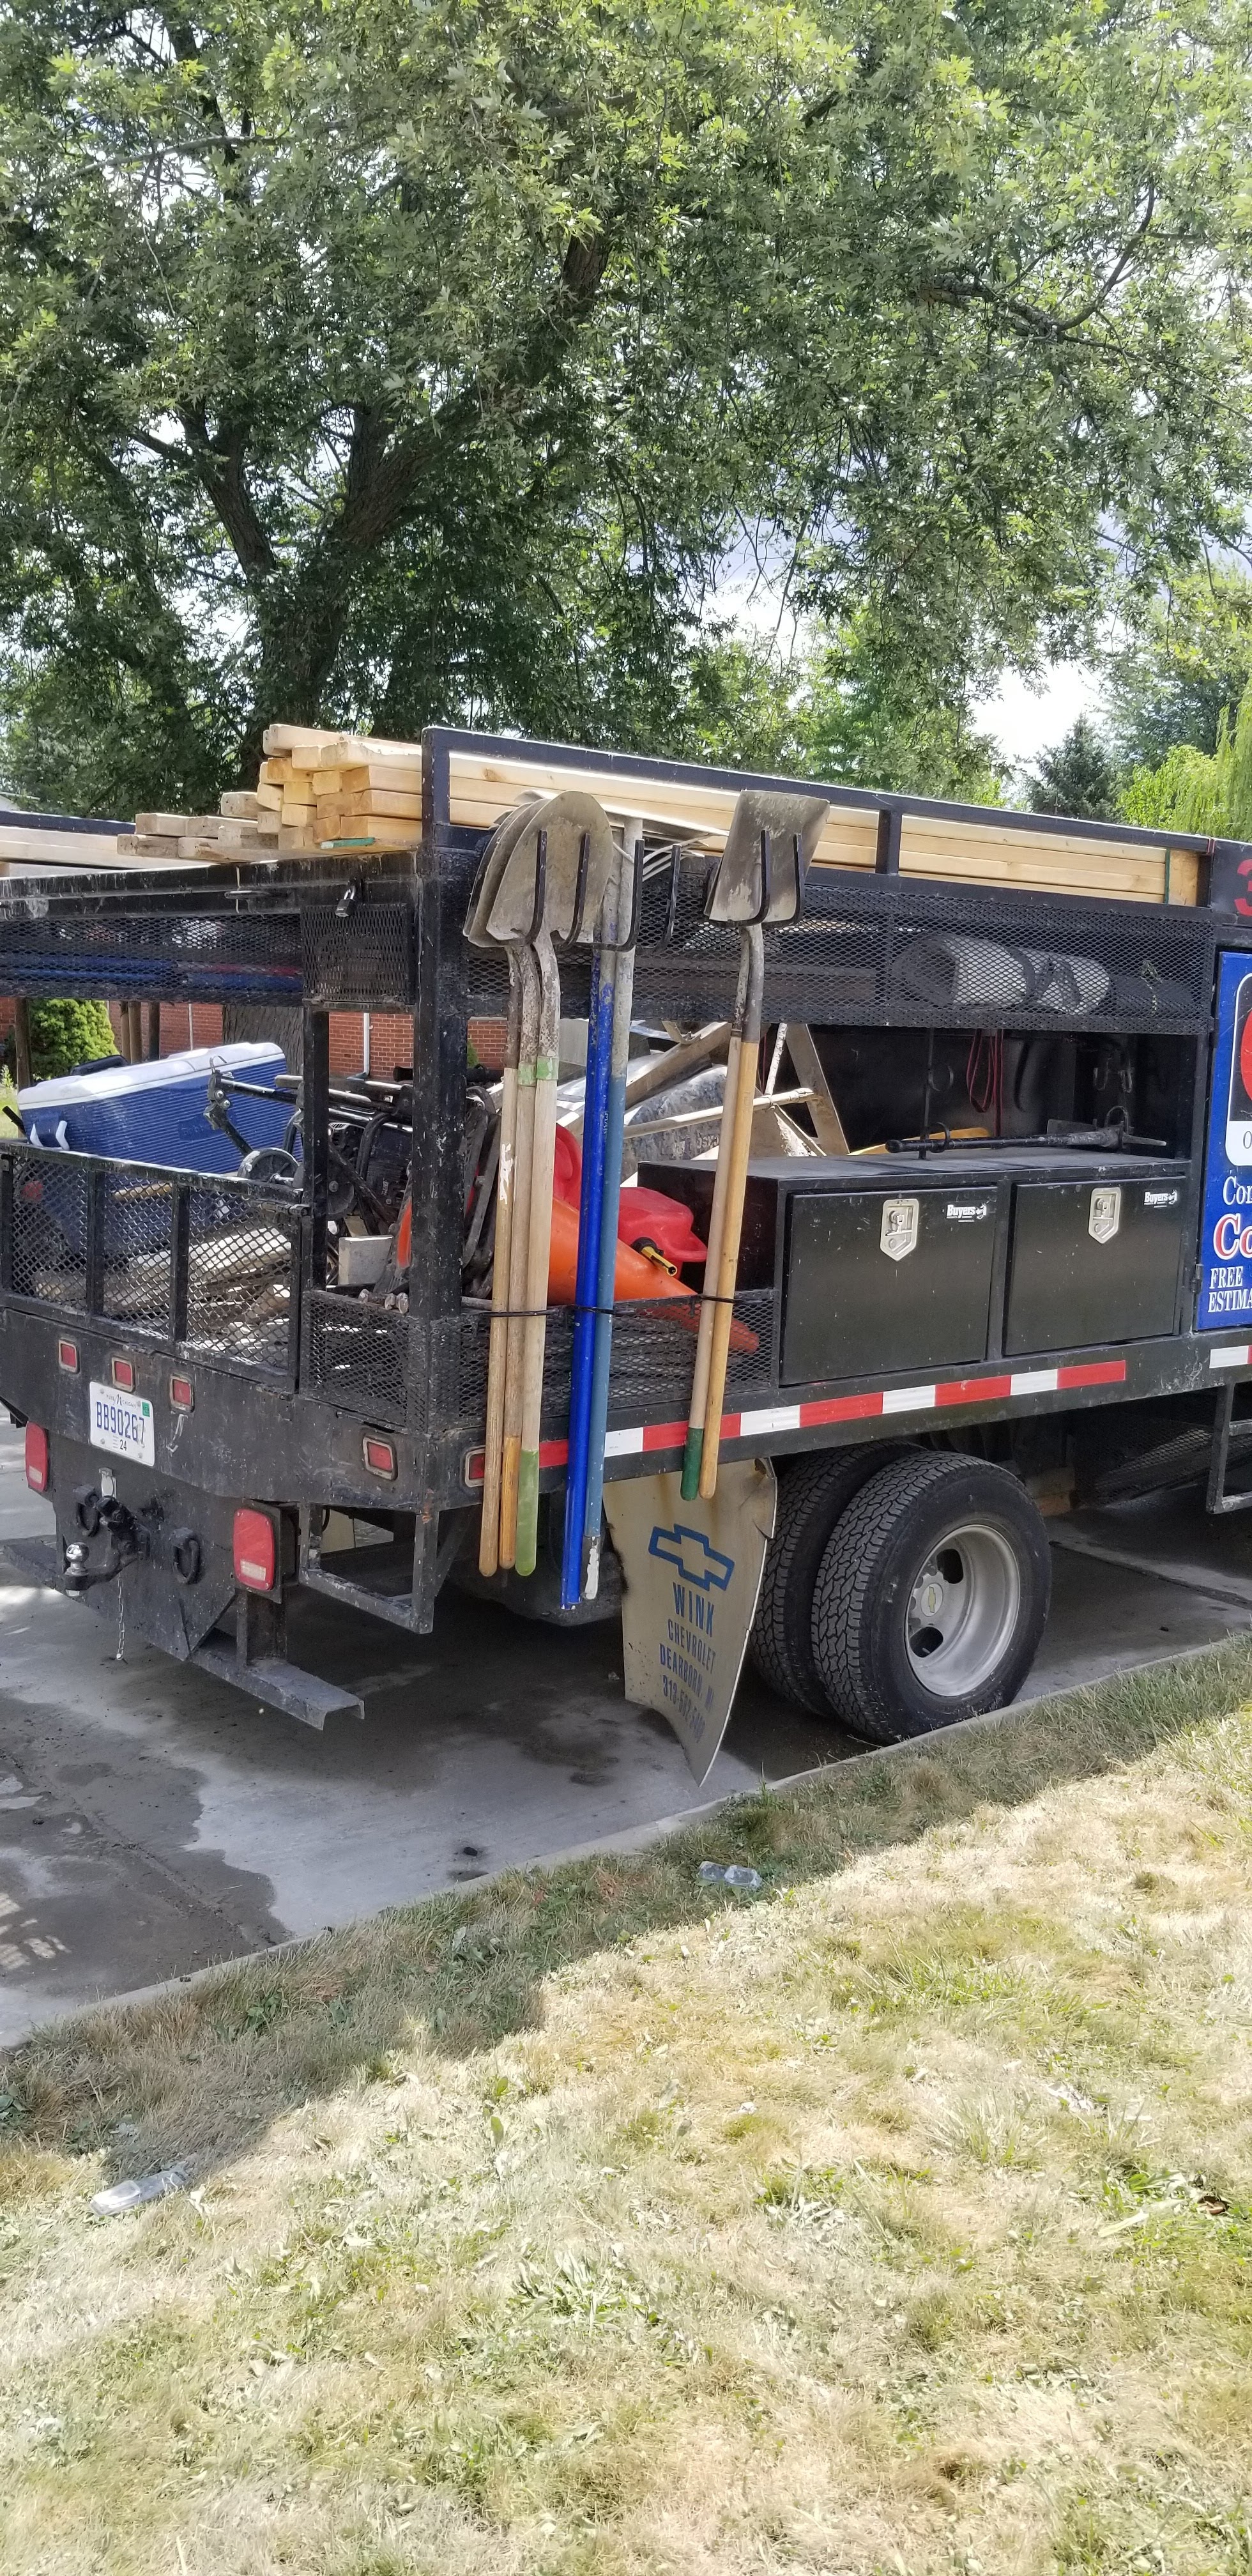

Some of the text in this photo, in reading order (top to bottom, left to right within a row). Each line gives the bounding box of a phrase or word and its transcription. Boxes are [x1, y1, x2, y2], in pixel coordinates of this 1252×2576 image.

[1144, 1192, 1169, 1205] Buyers
[946, 1204, 976, 1219] Buyers
[1209, 1266, 1244, 1289] FREE
[96, 1401, 144, 1444] BB90267
[119, 1439, 126, 1452] 24
[673, 1581, 714, 1637] WINK
[668, 1618, 715, 1674] CHEVROLET
